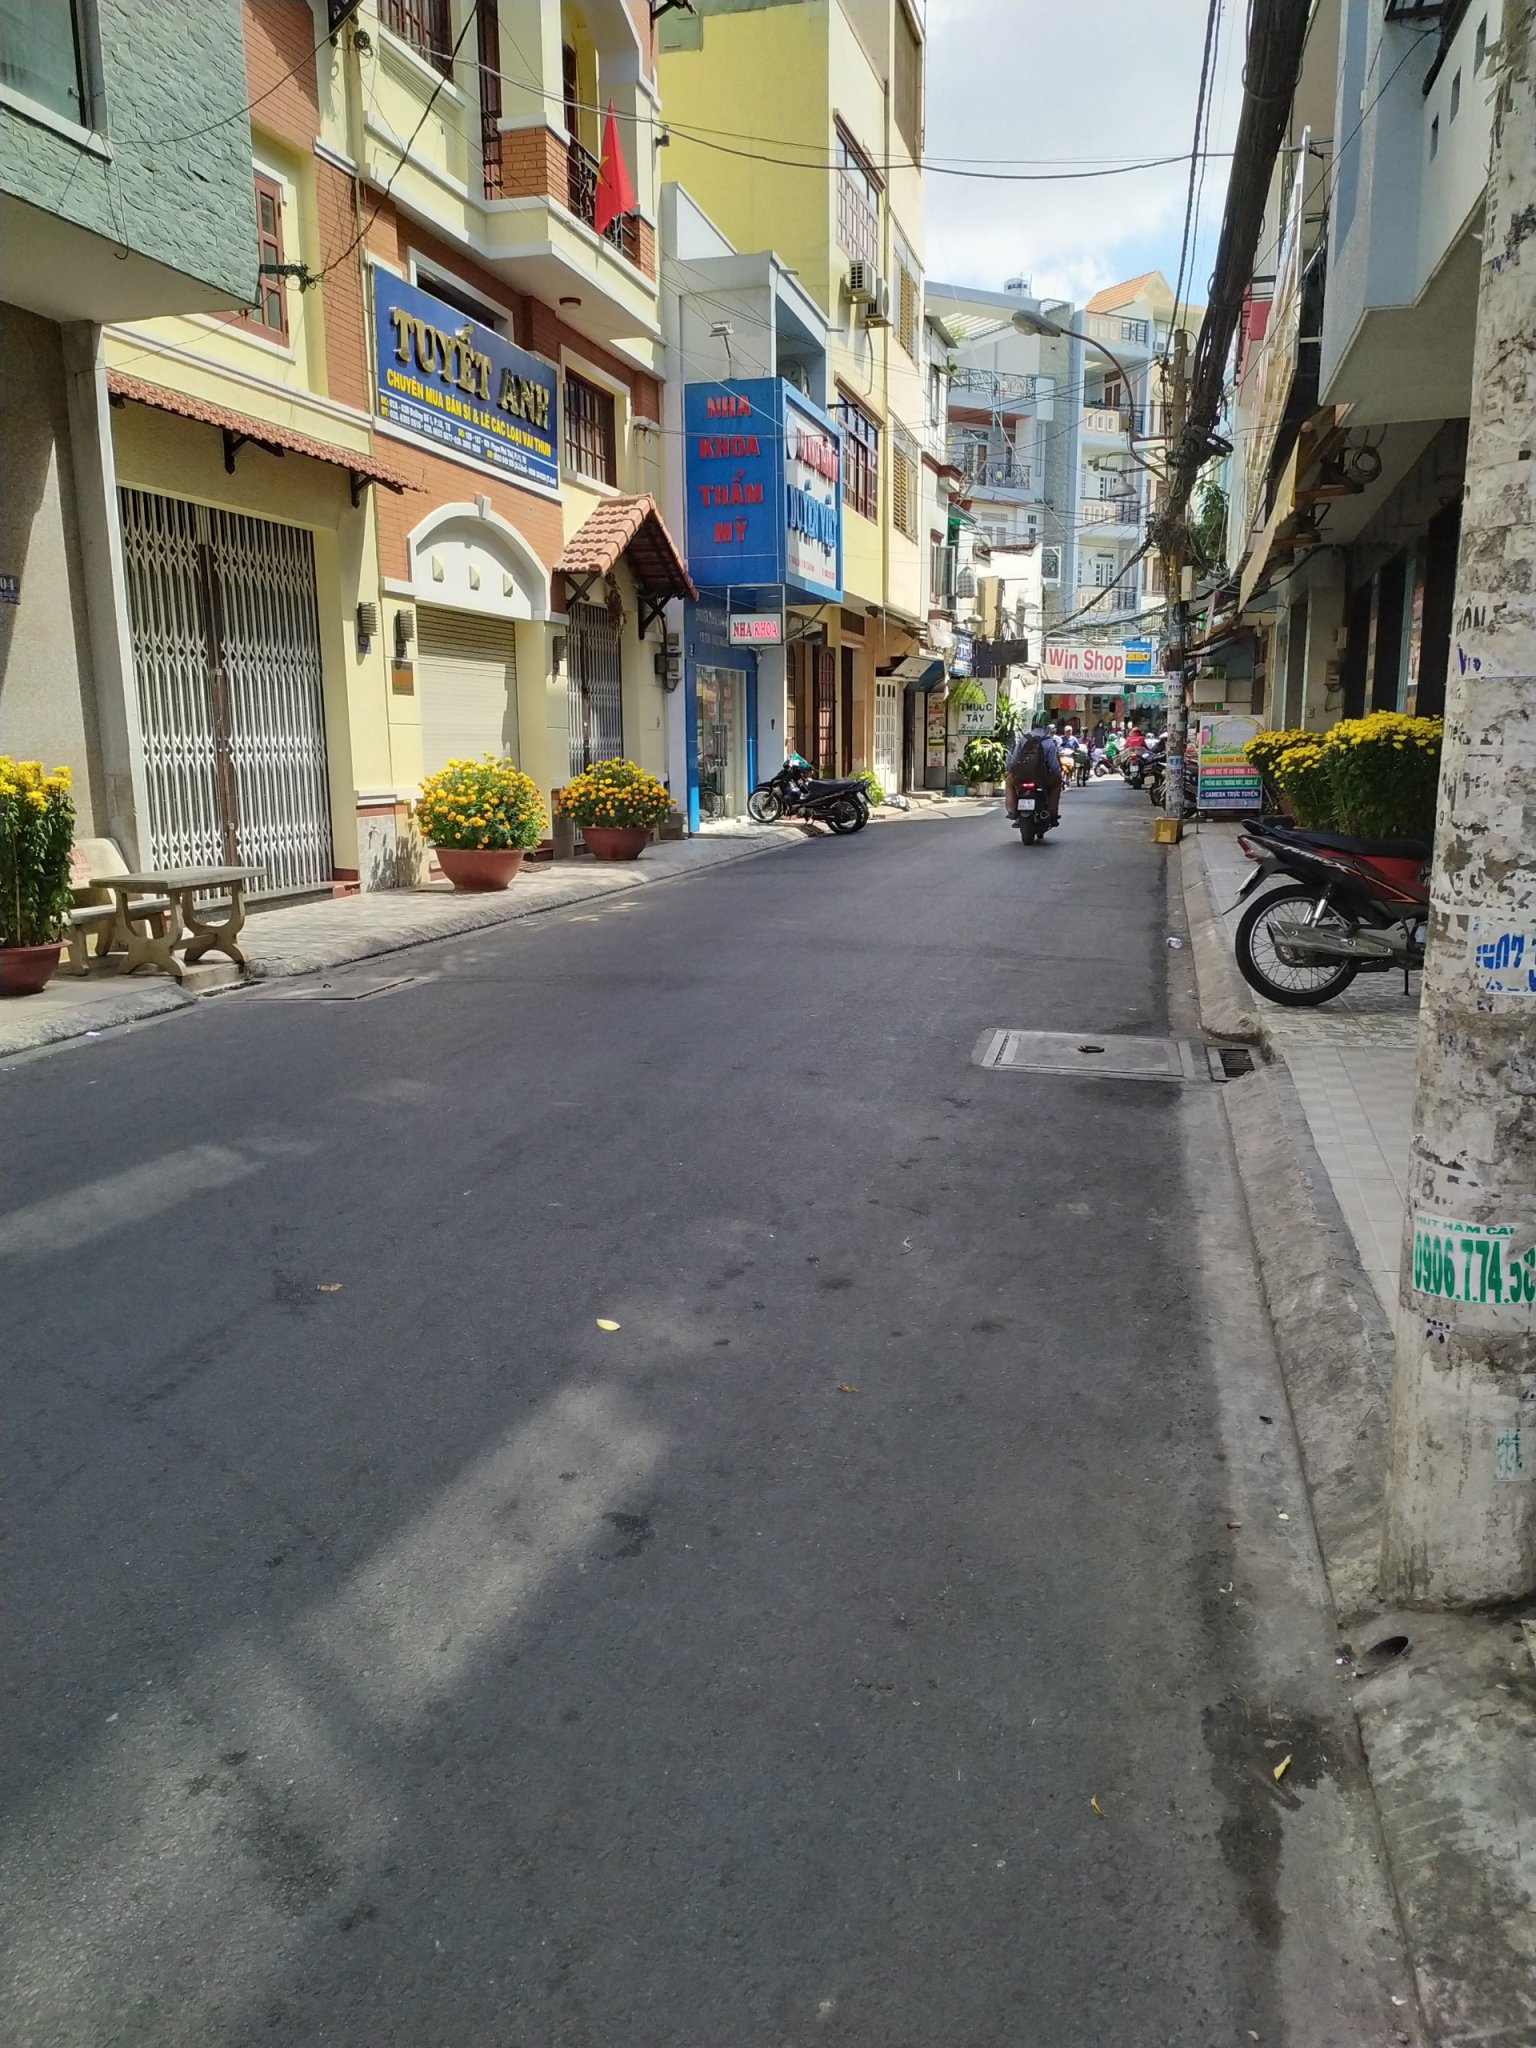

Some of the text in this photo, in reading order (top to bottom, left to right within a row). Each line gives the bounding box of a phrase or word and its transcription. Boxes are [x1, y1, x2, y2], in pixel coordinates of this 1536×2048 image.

[388, 306, 492, 401] TUYẾT
[499, 367, 551, 431] ANH
[387, 368, 423, 400] CHUYÊN
[425, 387, 443, 410] MUA
[445, 392, 463, 417] BÁN
[473, 409, 480, 424] &
[491, 411, 506, 436] CÁC
[507, 422, 521, 446] LOẠI
[533, 437, 551, 458] THUN
[706, 395, 751, 419] NHA
[699, 434, 760, 459] KHOA
[698, 469, 763, 507] THẨM
[713, 516, 748, 543] MỸ
[733, 620, 779, 638] NHA KHOA
[1048, 648, 1078, 670] Win
[1083, 649, 1123, 677] Shop
[966, 711, 985, 722] TÂY
